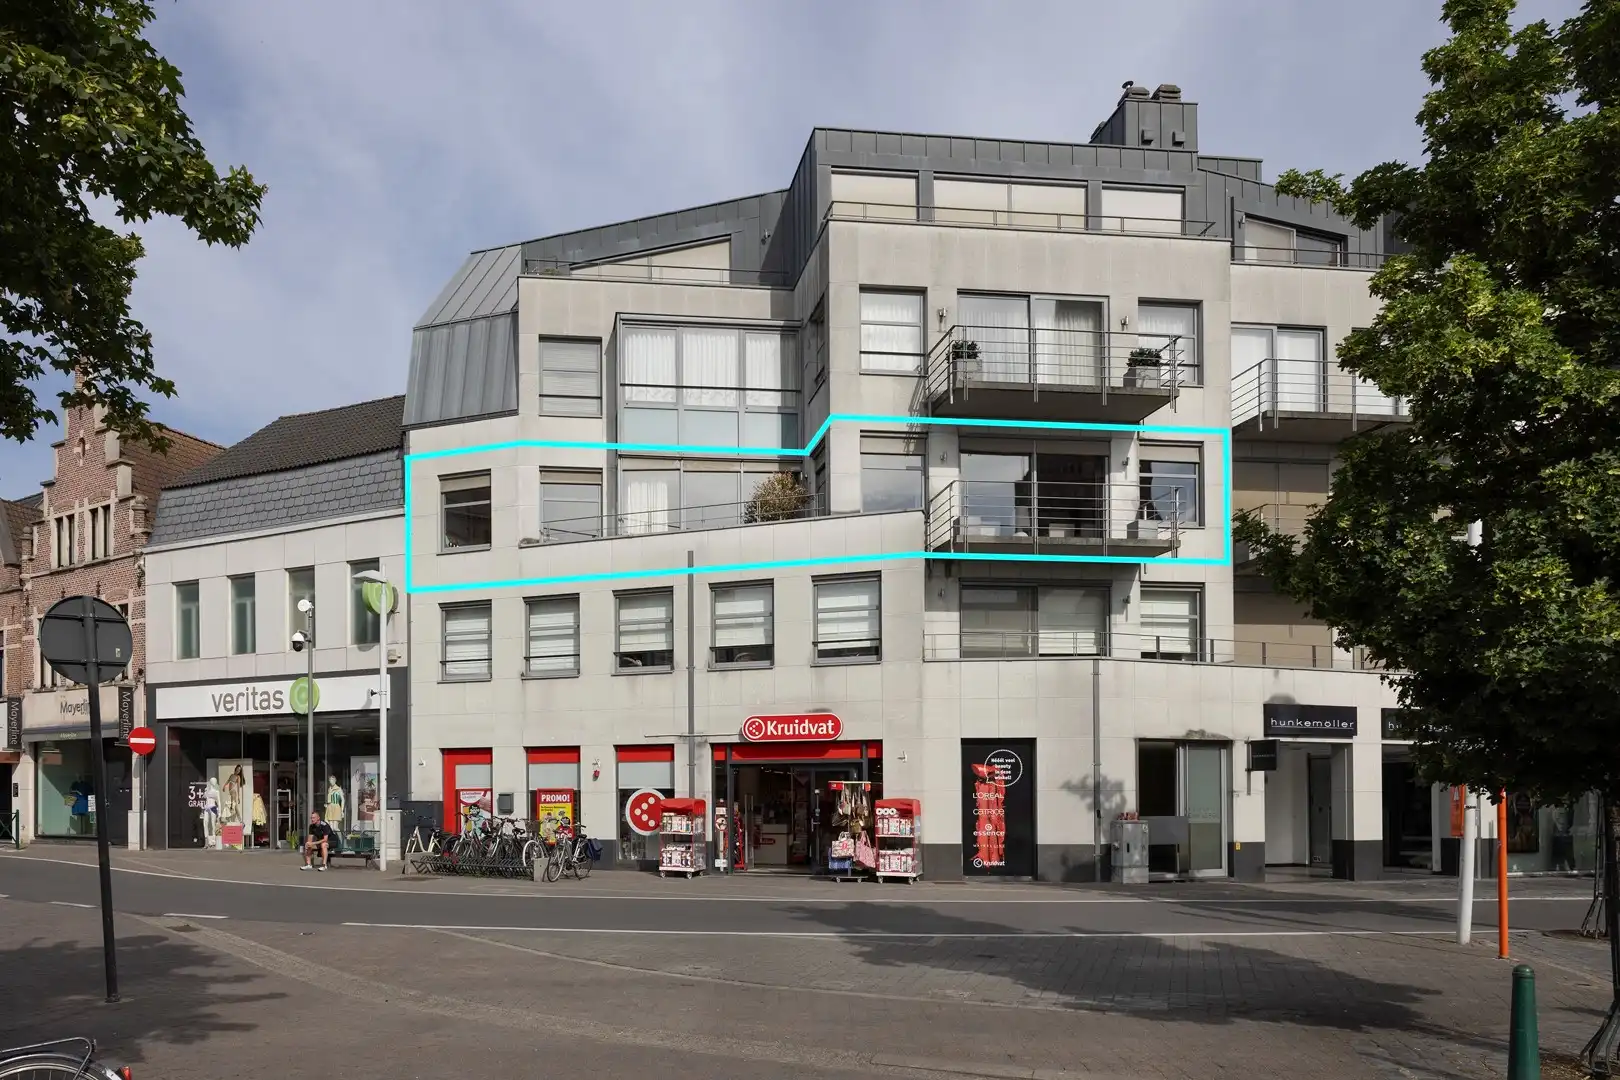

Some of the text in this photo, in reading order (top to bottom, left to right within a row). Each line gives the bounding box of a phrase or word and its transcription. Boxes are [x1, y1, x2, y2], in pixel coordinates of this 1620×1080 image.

[211, 686, 284, 712] veritas
[9, 701, 20, 745] Mayerline
[120, 691, 132, 740] Mayerline
[767, 718, 835, 736] Kruidvat
[541, 794, 570, 802] PROMO!
